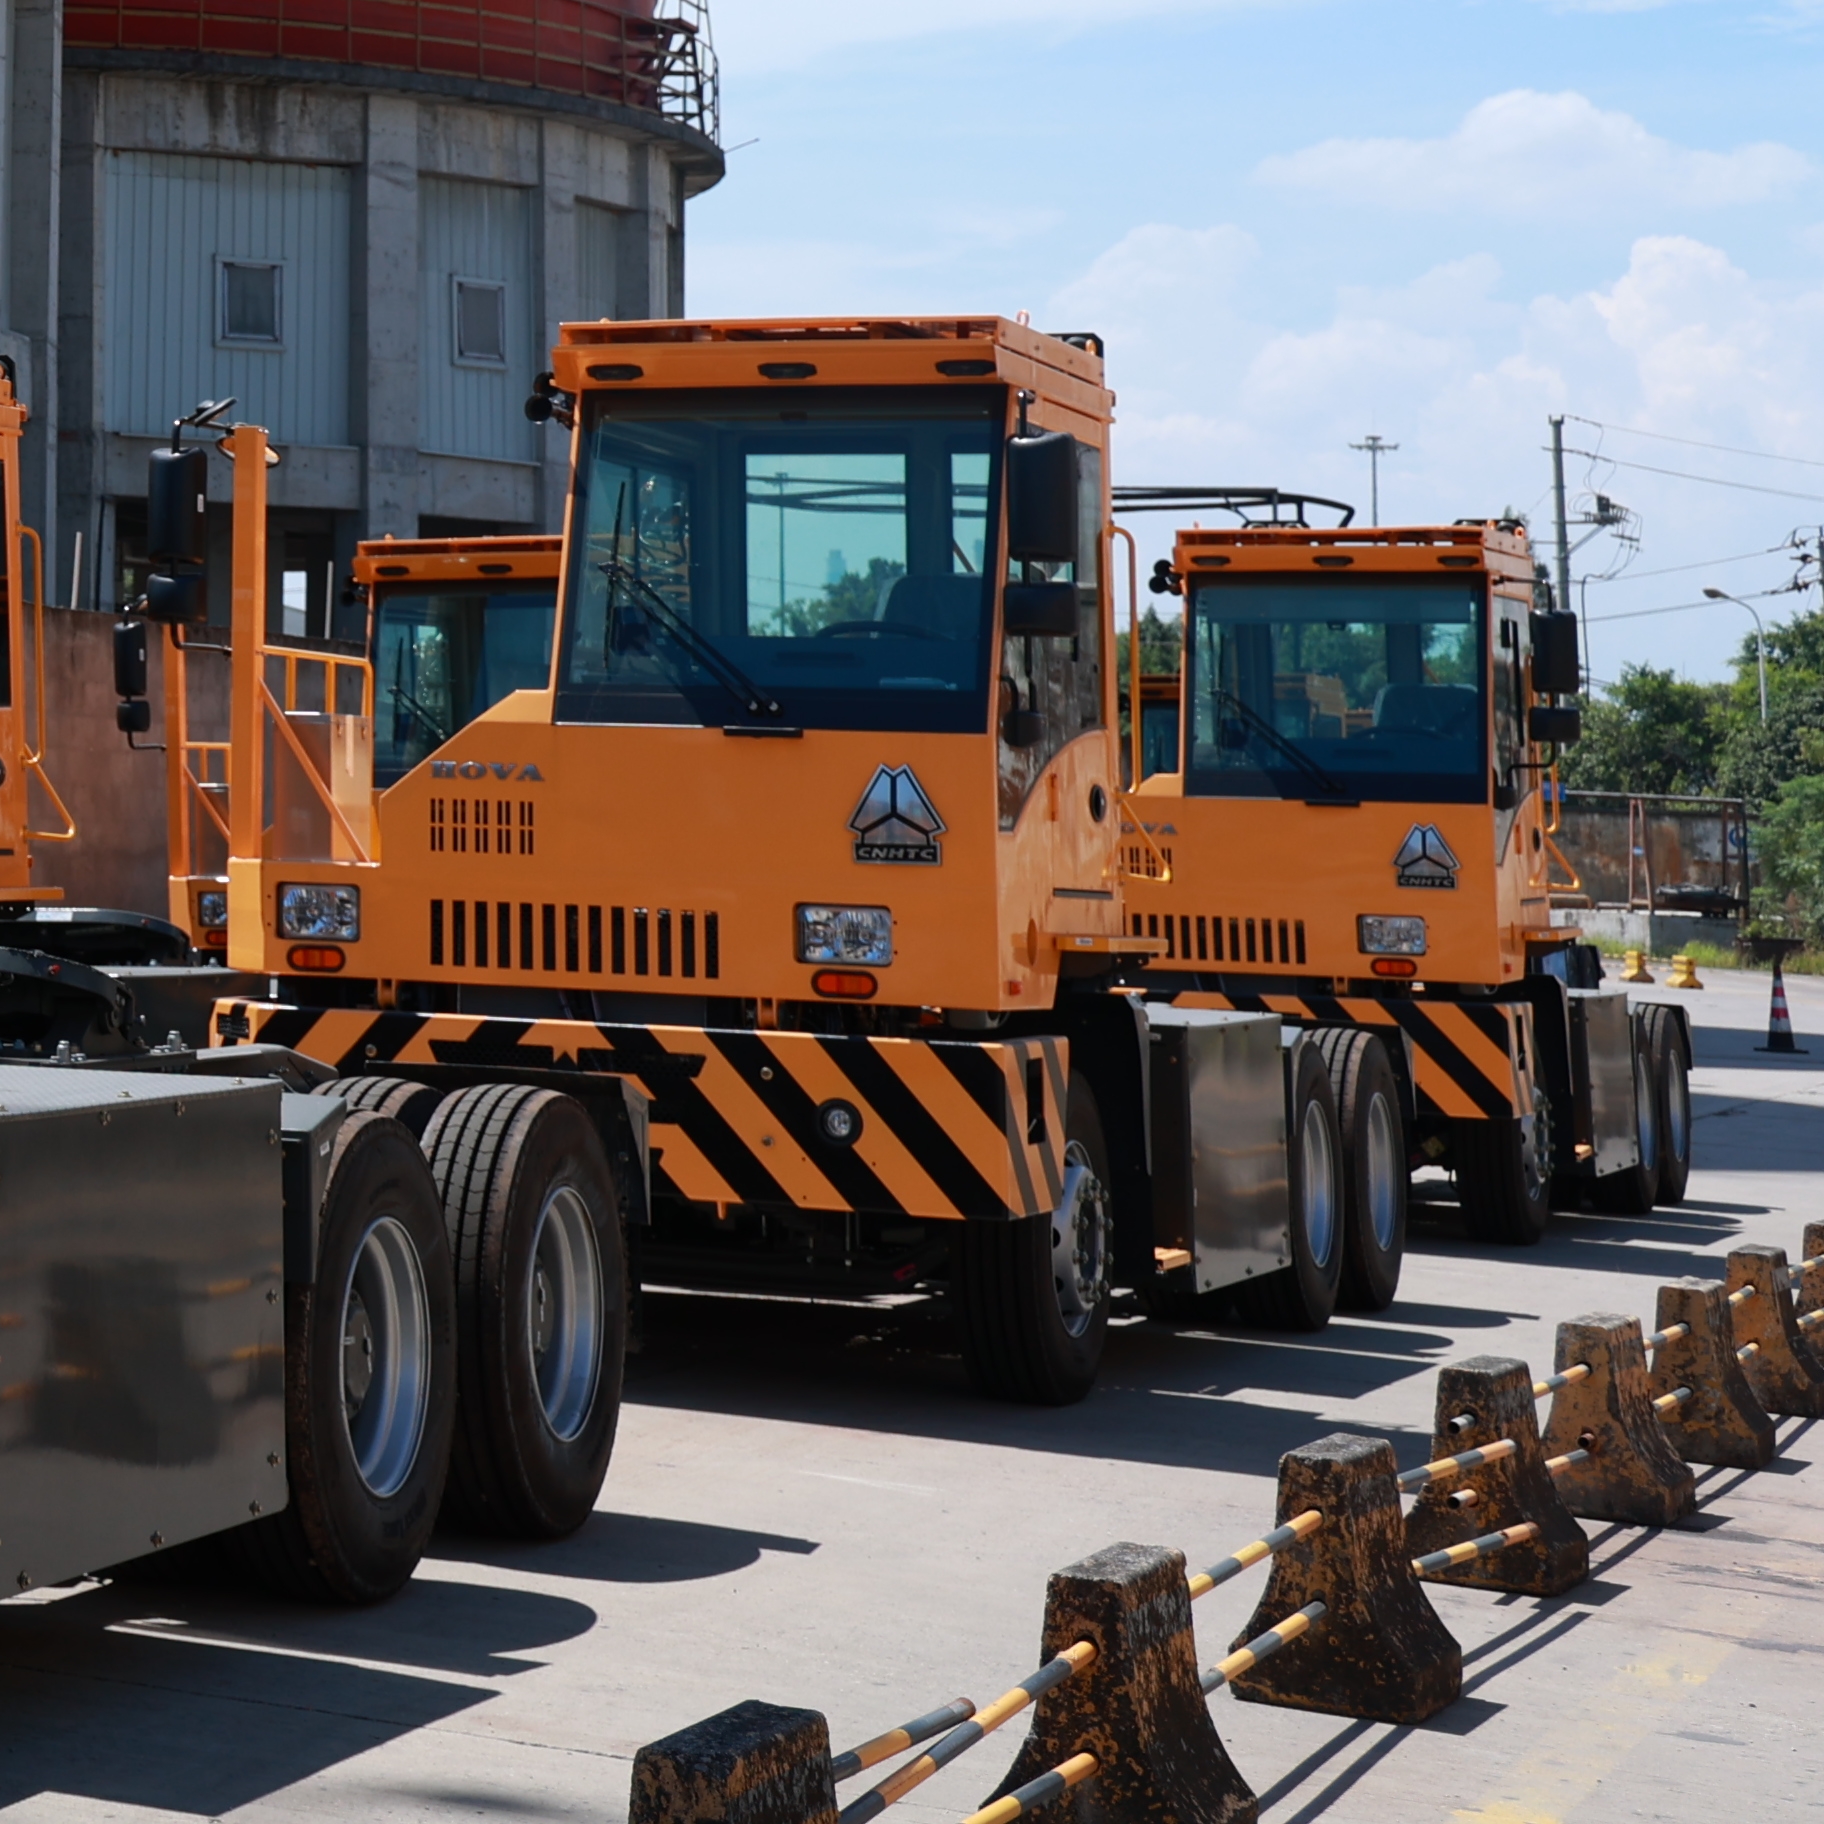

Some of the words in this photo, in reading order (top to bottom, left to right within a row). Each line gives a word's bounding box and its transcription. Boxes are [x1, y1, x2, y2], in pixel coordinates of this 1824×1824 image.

[430, 760, 545, 782] HOVA
[1121, 821, 1179, 836] OVA
[858, 847, 935, 860] CNHTC
[1400, 877, 1453, 887] CNHTC
